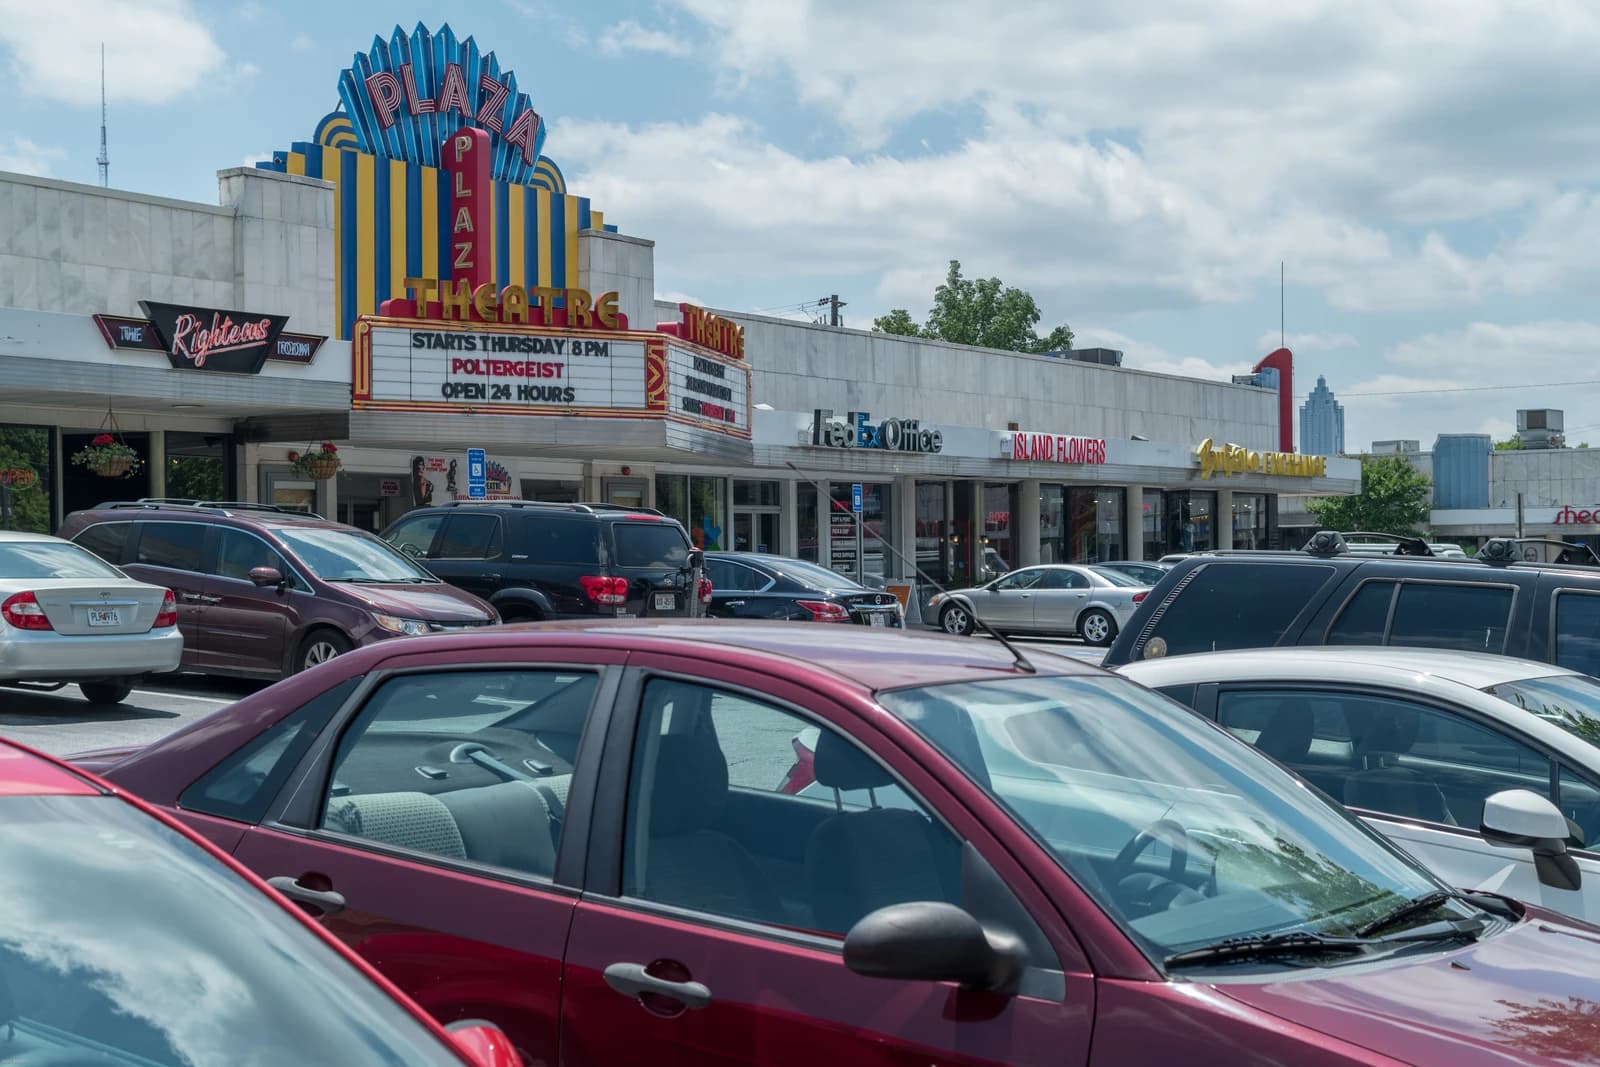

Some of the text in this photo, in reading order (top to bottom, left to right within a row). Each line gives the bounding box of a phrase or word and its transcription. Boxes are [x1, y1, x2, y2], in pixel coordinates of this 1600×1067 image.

[366, 62, 540, 167] PLAZA
[404, 278, 620, 329] THEATRE
[118, 326, 143, 342] THE
[172, 311, 272, 367] Righteous
[412, 332, 609, 357] STARTS THURSDAY 8 PM
[681, 303, 745, 359] THEATRE
[451, 358, 565, 379] POLTERGEIST
[441, 382, 576, 403] OPEN 24 HOURS
[812, 408, 943, 454] FedEx Office
[1013, 433, 1106, 465] ISLAND FLOWERS
